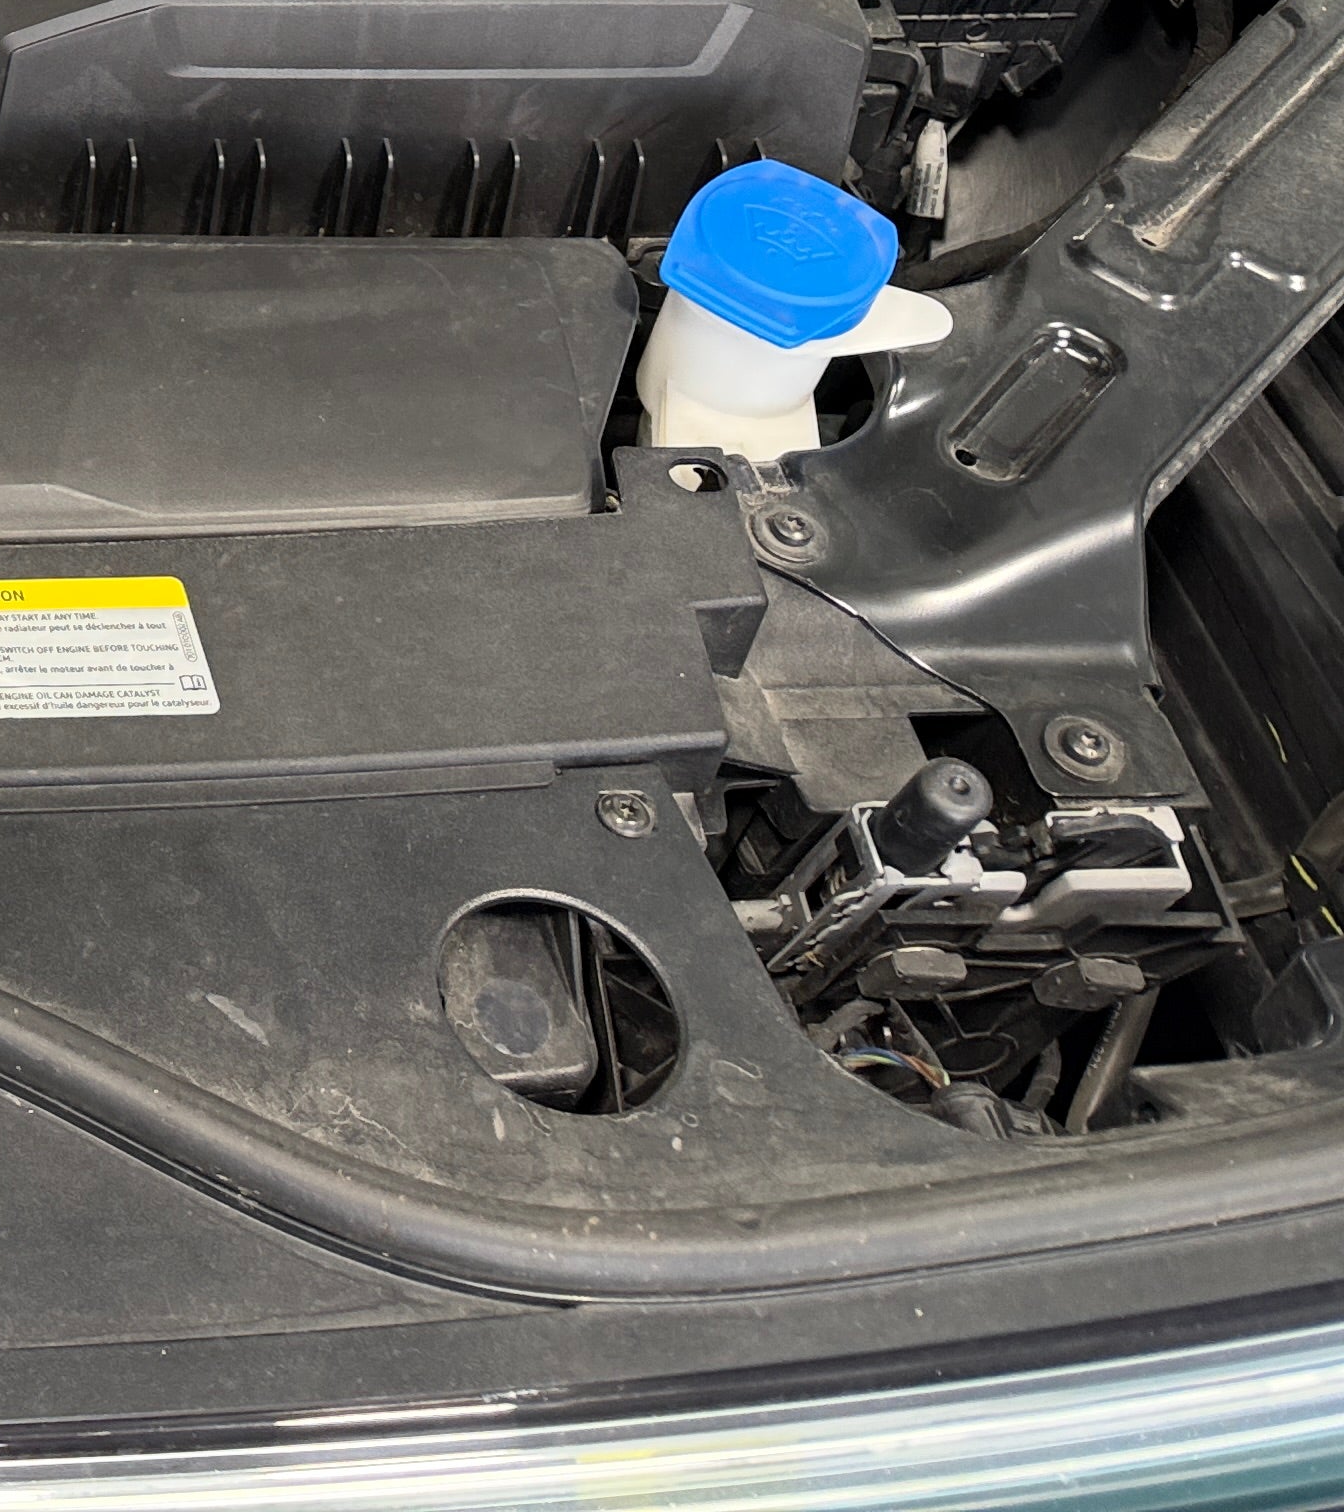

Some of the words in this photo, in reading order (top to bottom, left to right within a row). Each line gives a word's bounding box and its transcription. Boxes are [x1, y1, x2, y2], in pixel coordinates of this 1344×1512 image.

[11, 613, 39, 622] START
[40, 613, 52, 621] AT
[3, 624, 46, 633] radiateur
[48, 624, 71, 633] peut
[72, 623, 83, 631] se
[146, 622, 167, 630] tout
[0, 646, 34, 654] SWITCH
[36, 646, 54, 654] OFF
[56, 645, 90, 653] ENGINE
[92, 644, 129, 653] BEFORE
[132, 643, 179, 651] TOUCHING
[39, 665, 48, 673] le
[50, 665, 85, 674] moteur
[87, 664, 114, 673] avant
[115, 664, 128, 672] de
[130, 663, 166, 672] toucher
[36, 691, 52, 699] OIL
[53, 691, 74, 699] CAN
[75, 690, 115, 699] DAMAGE
[3, 701, 40, 710] excessif
[76, 701, 125, 711] dangereux
[127, 700, 149, 709] pour
[151, 699, 160, 707] le
